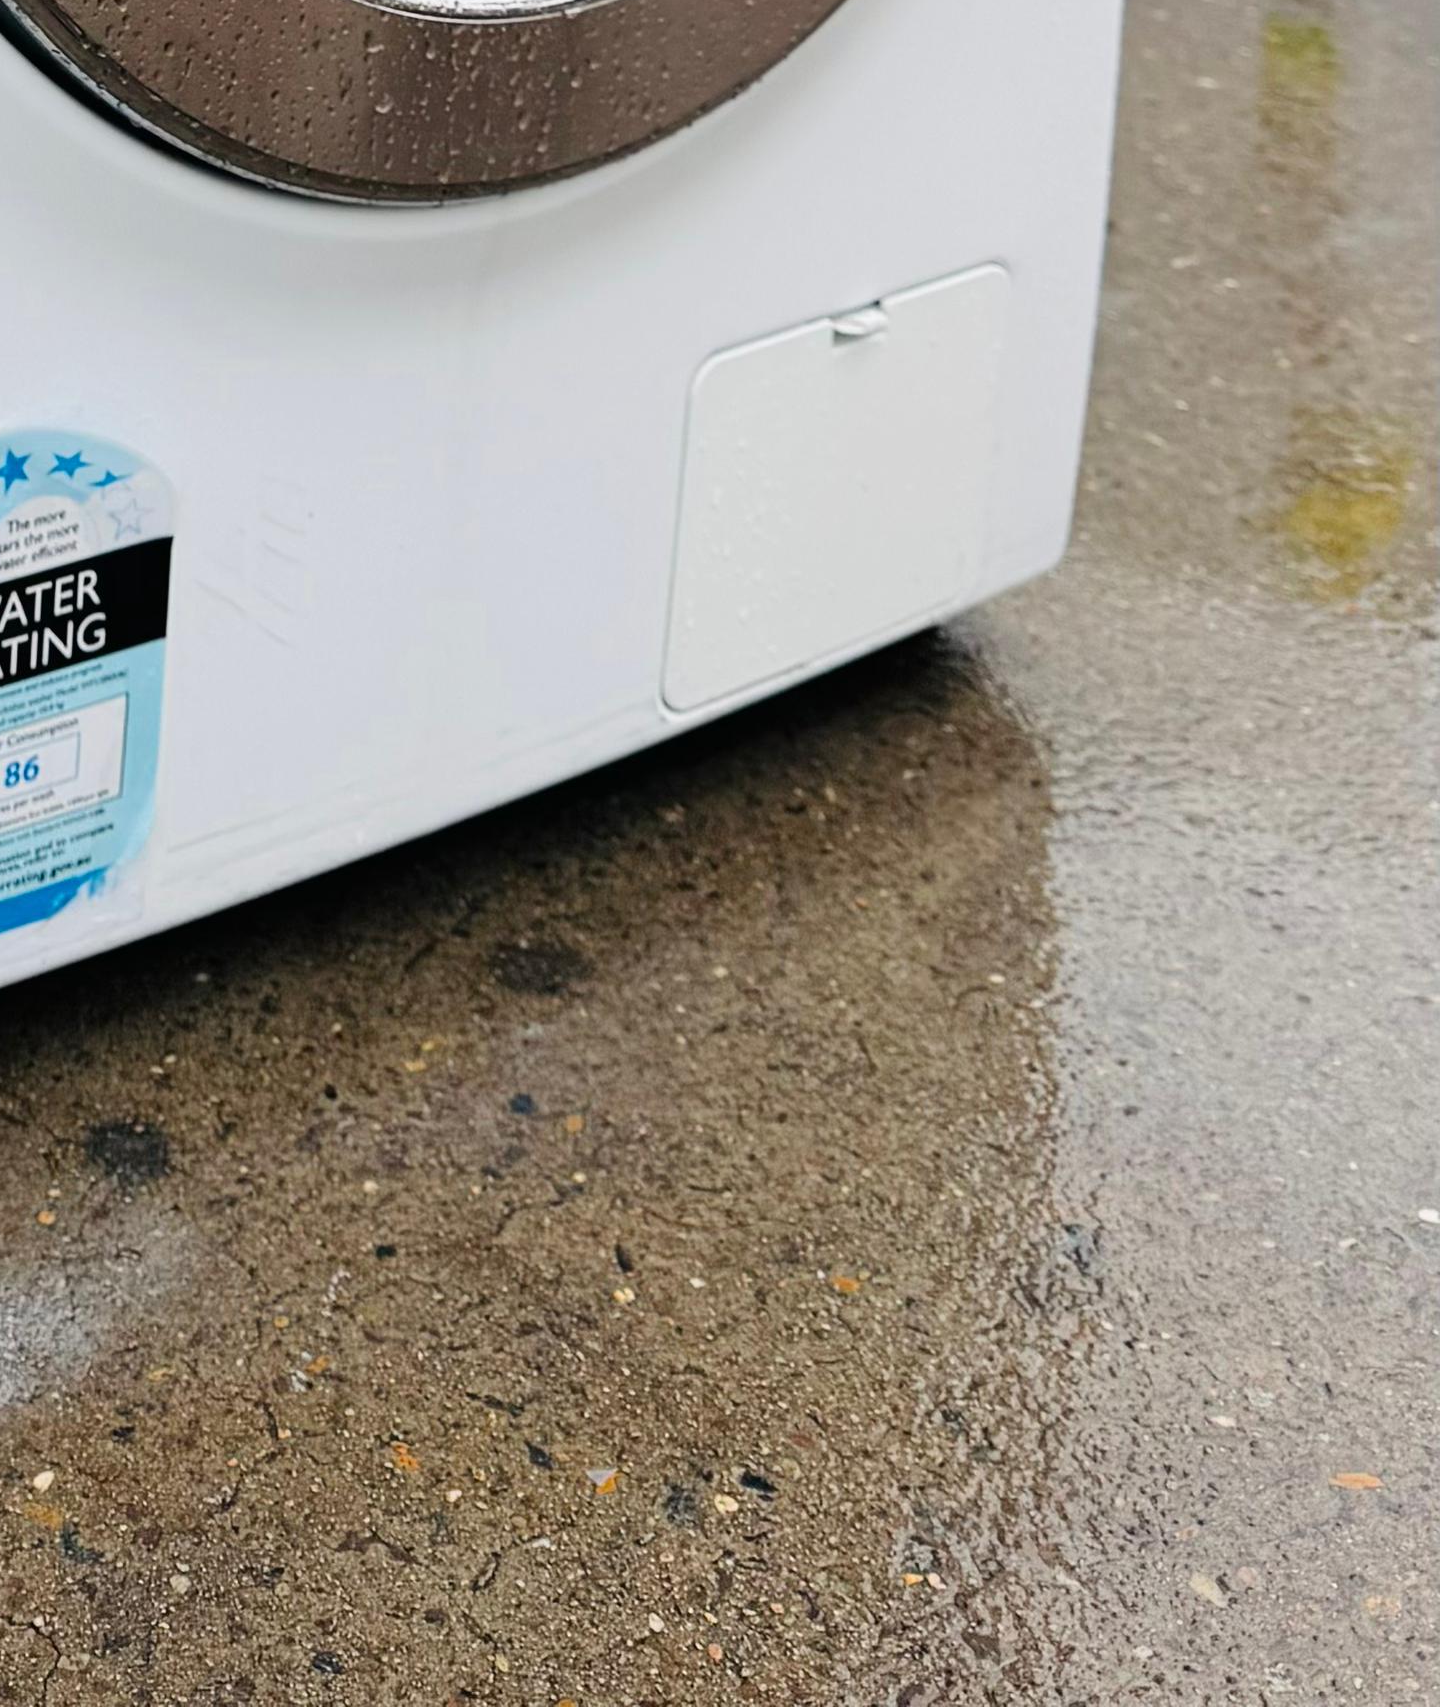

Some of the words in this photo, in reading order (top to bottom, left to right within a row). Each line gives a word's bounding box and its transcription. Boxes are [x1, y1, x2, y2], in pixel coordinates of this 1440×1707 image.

[6, 518, 30, 535] The
[33, 509, 67, 526] more
[22, 532, 44, 549] the
[45, 522, 80, 541] more
[31, 539, 79, 563] efficient
[2, 753, 40, 789] 86
